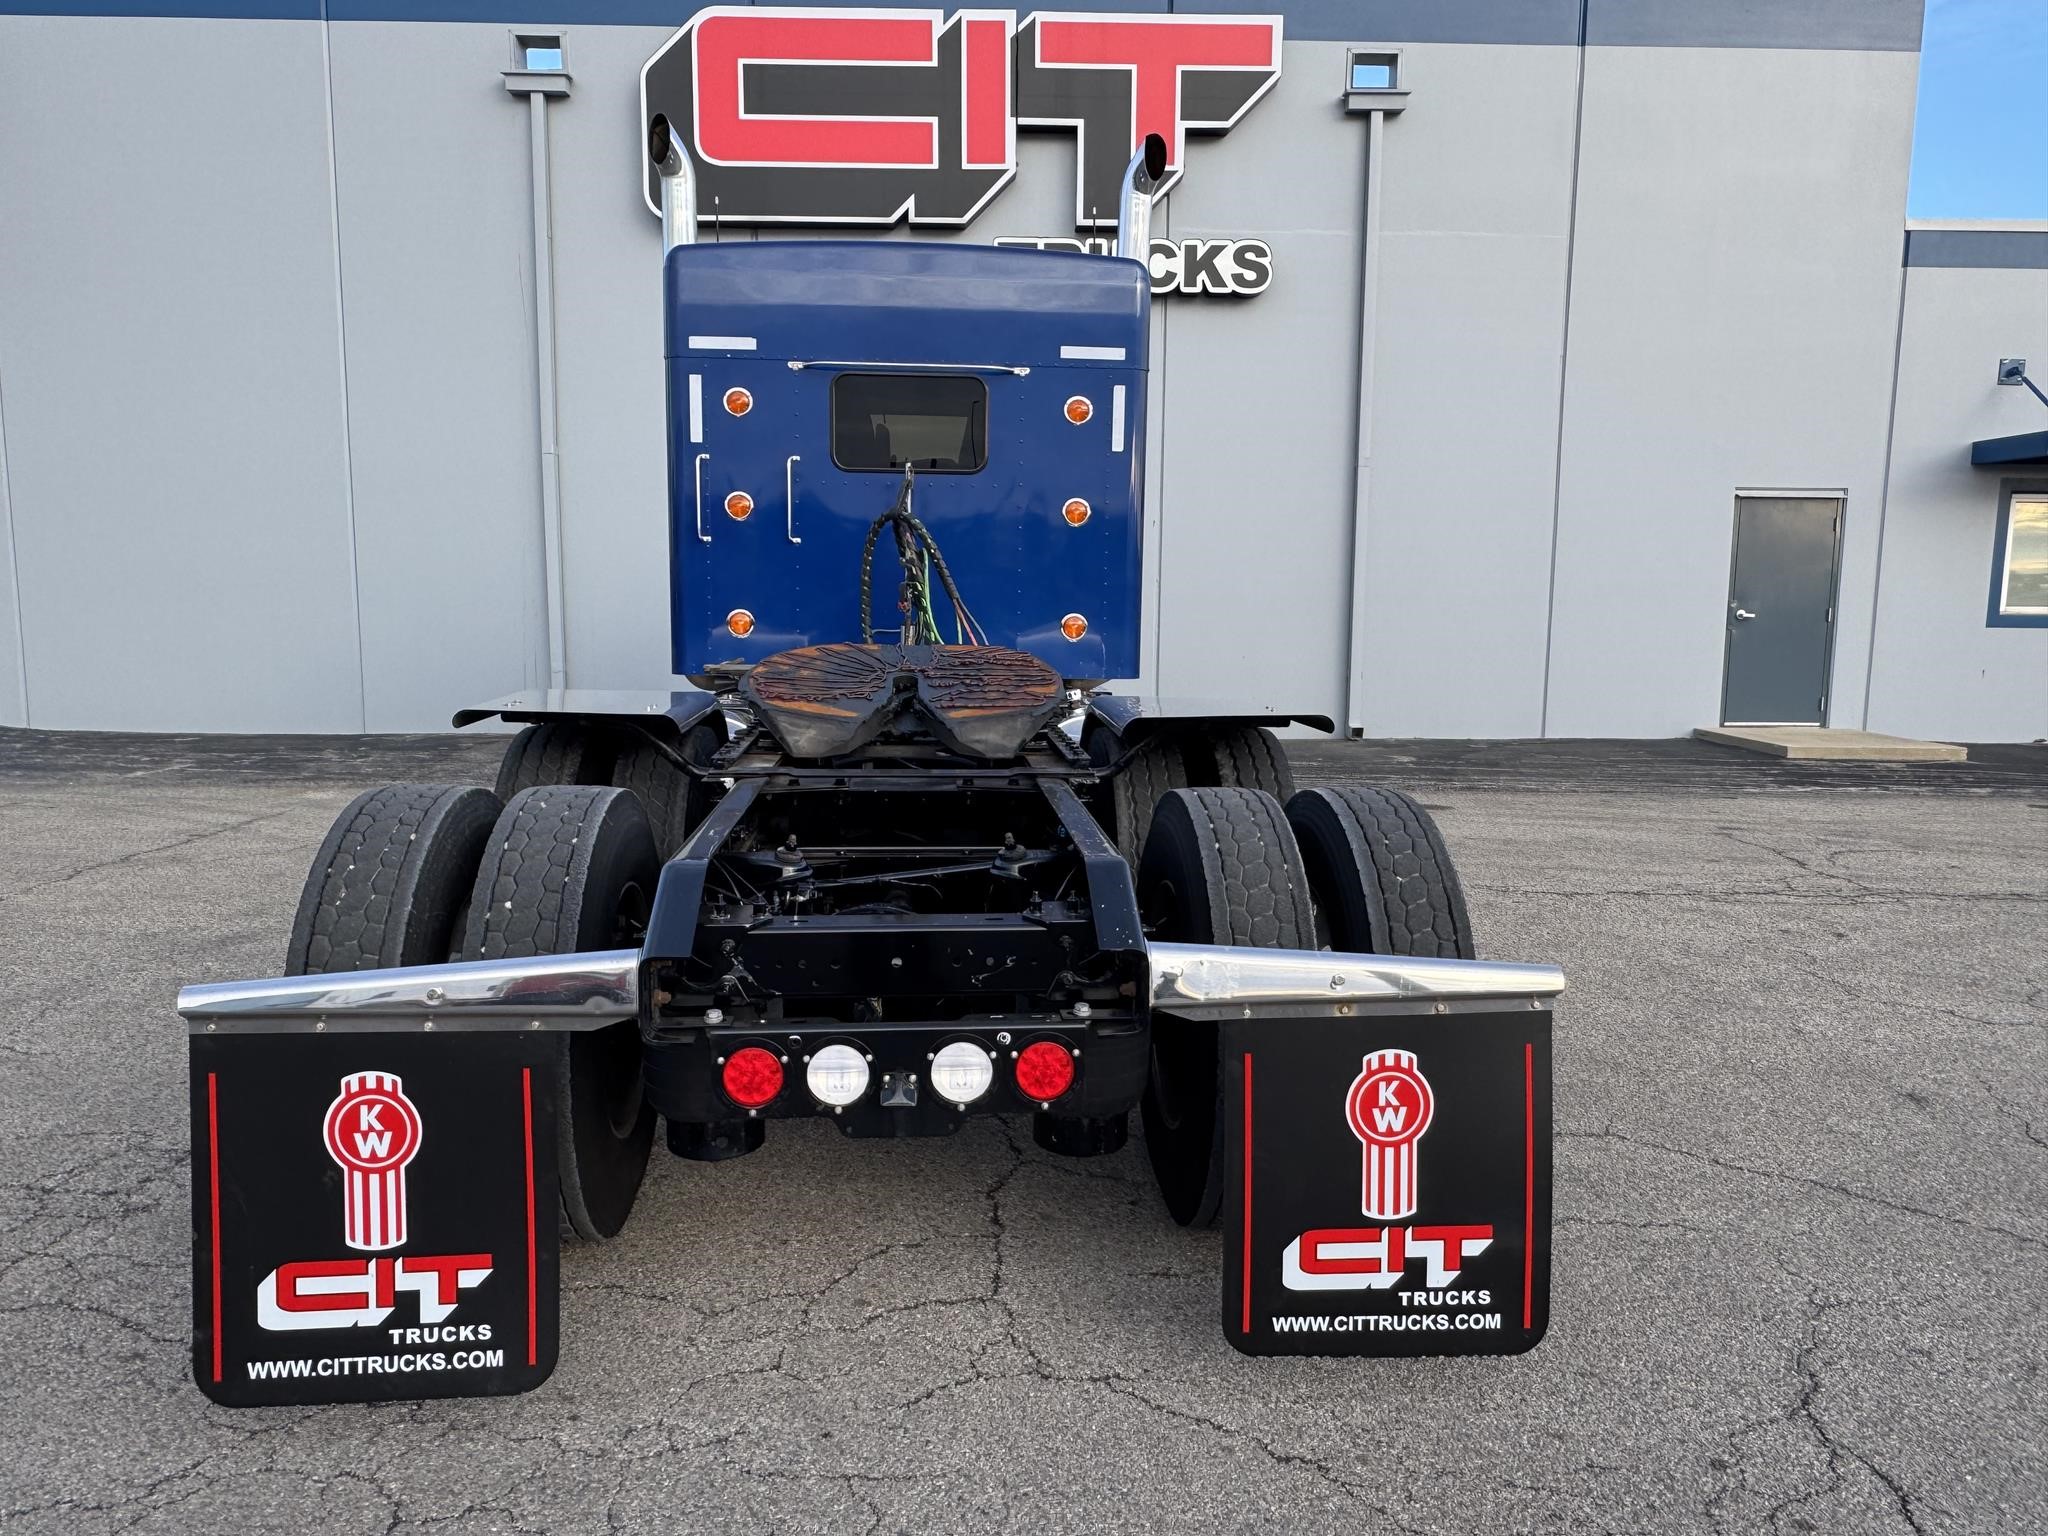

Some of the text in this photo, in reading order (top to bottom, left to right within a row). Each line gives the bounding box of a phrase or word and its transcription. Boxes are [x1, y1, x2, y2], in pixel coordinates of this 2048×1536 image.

[641, 6, 1283, 226] CIT
[994, 237, 1272, 299] CKS
[1378, 1080, 1400, 1107] K
[359, 1104, 385, 1131] K
[1372, 1106, 1408, 1133] W
[352, 1131, 393, 1159] W
[1282, 1224, 1494, 1291] CIT
[257, 1253, 495, 1331] CIT
[1398, 1290, 1492, 1306] TRUCKS
[388, 1324, 493, 1345] TRUCKS
[1272, 1313, 1502, 1333] WWW.CITTRUCKS.COM
[246, 1349, 504, 1380] WWW.CITTRUCKS.COM
